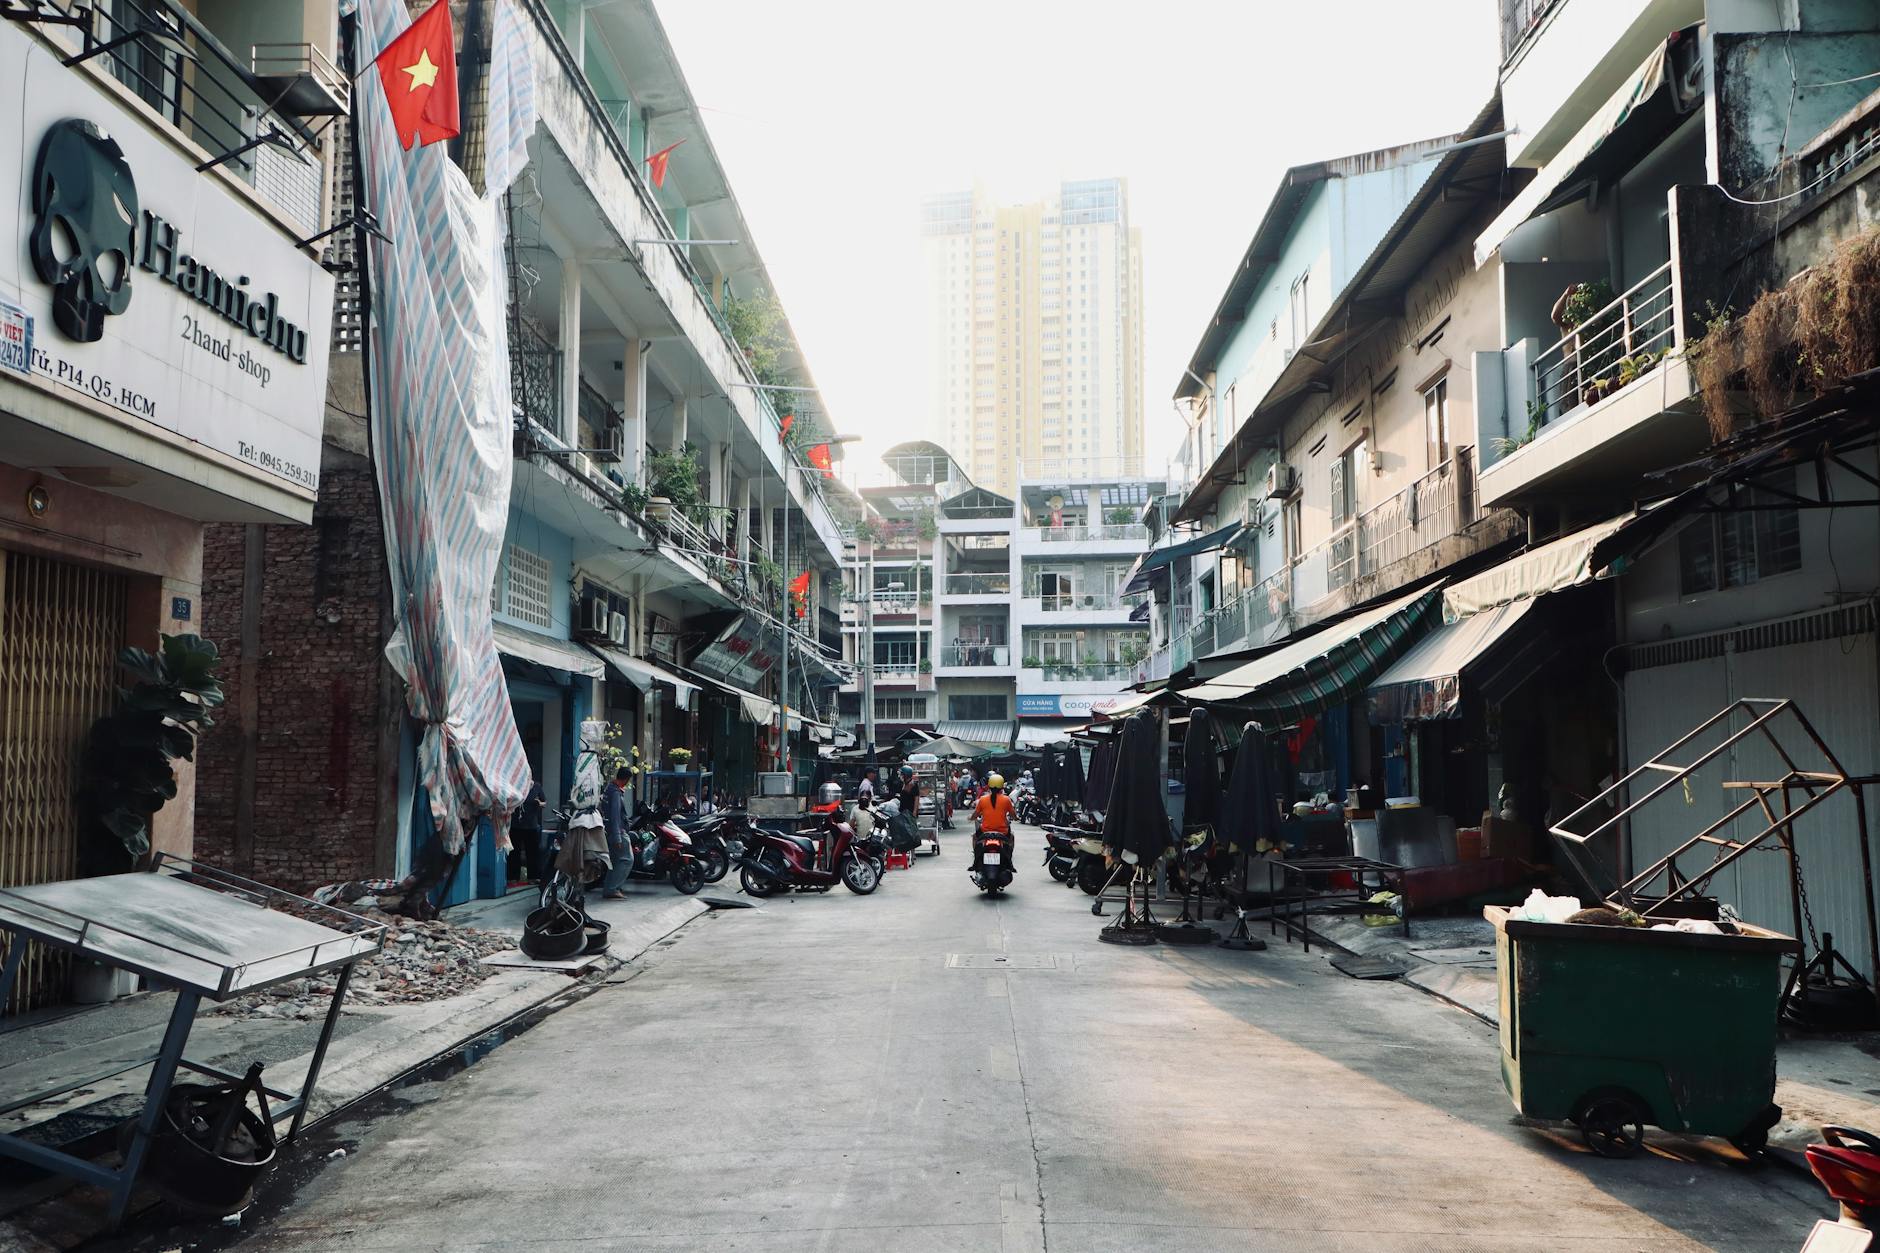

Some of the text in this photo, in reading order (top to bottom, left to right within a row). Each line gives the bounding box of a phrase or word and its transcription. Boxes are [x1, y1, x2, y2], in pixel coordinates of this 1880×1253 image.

[139, 209, 308, 365] Hamichu
[121, 388, 156, 418] HCM
[238, 440, 316, 487] Tel: 0945.259.311
